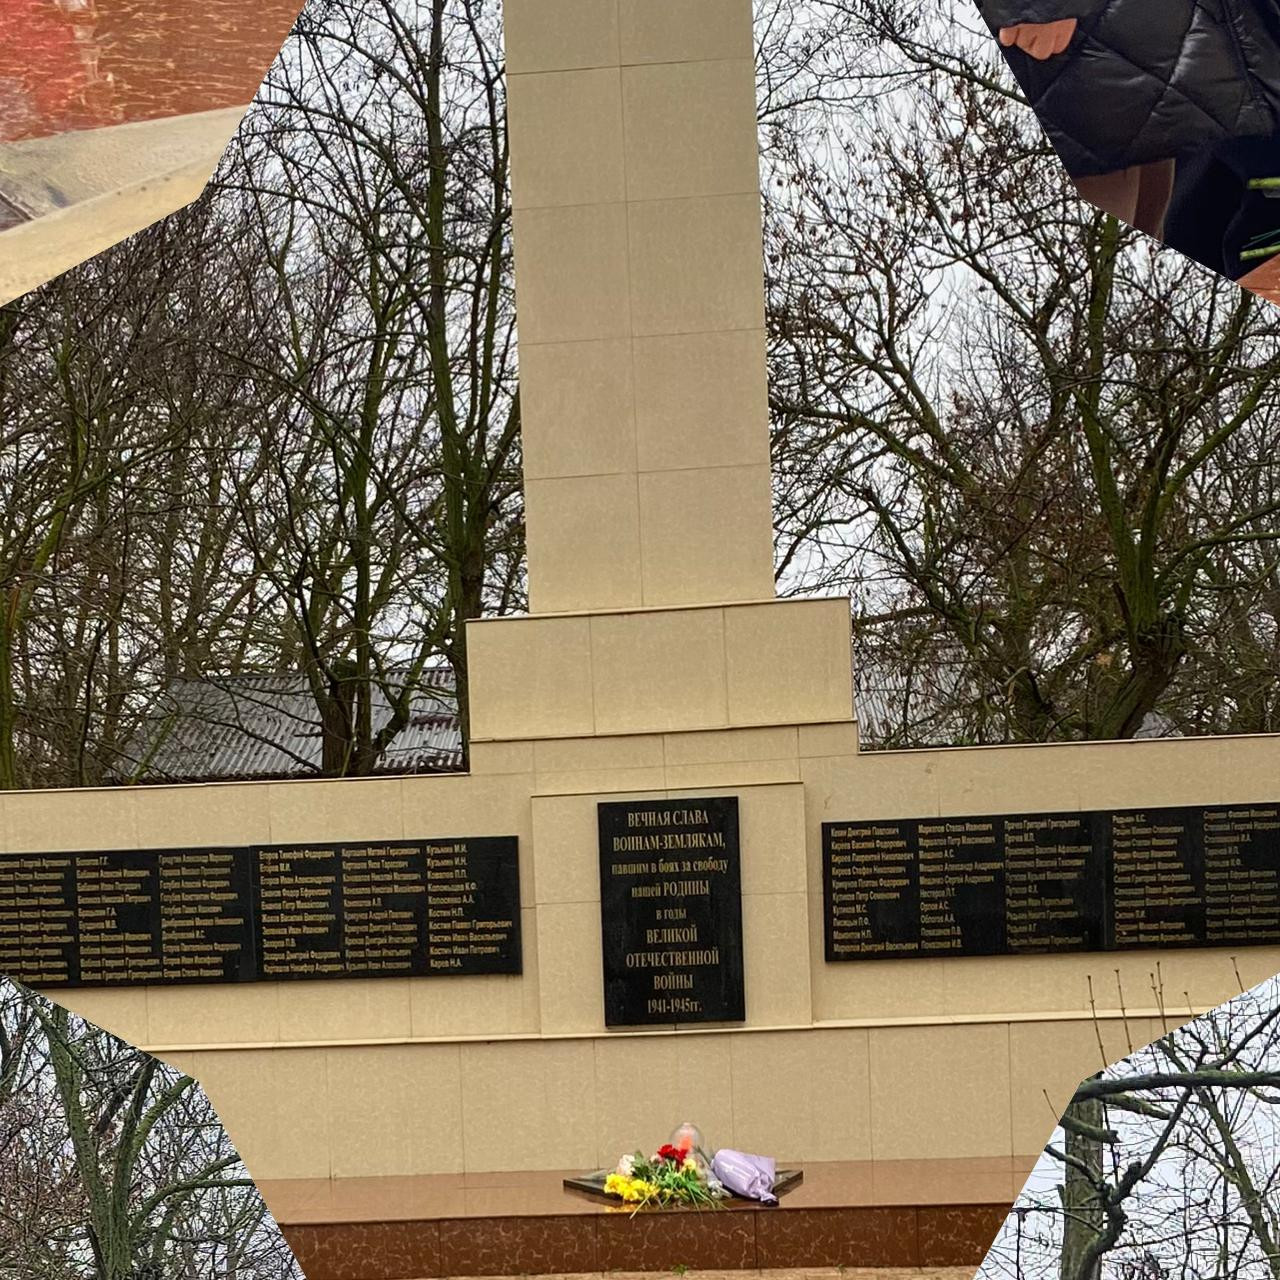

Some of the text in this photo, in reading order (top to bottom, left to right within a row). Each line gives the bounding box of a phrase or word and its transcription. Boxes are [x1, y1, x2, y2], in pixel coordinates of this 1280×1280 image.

[628, 810, 709, 827] ВЕЧНАЯ СЛАВА
[613, 832, 725, 851] ВОИНАМ-ЗЕМЛЯКАМ,
[612, 856, 728, 875] павшим в боях за свободу
[631, 880, 709, 898] нашей РОДИНЫ
[656, 908, 687, 920] в годы
[646, 924, 697, 944] ВЕЛИКОЙ
[626, 946, 719, 968] ОТЕЧЕСТВЕННОЙ
[654, 972, 693, 990] ВОЙНЫ
[648, 998, 702, 1013] 1941-1945гг.
